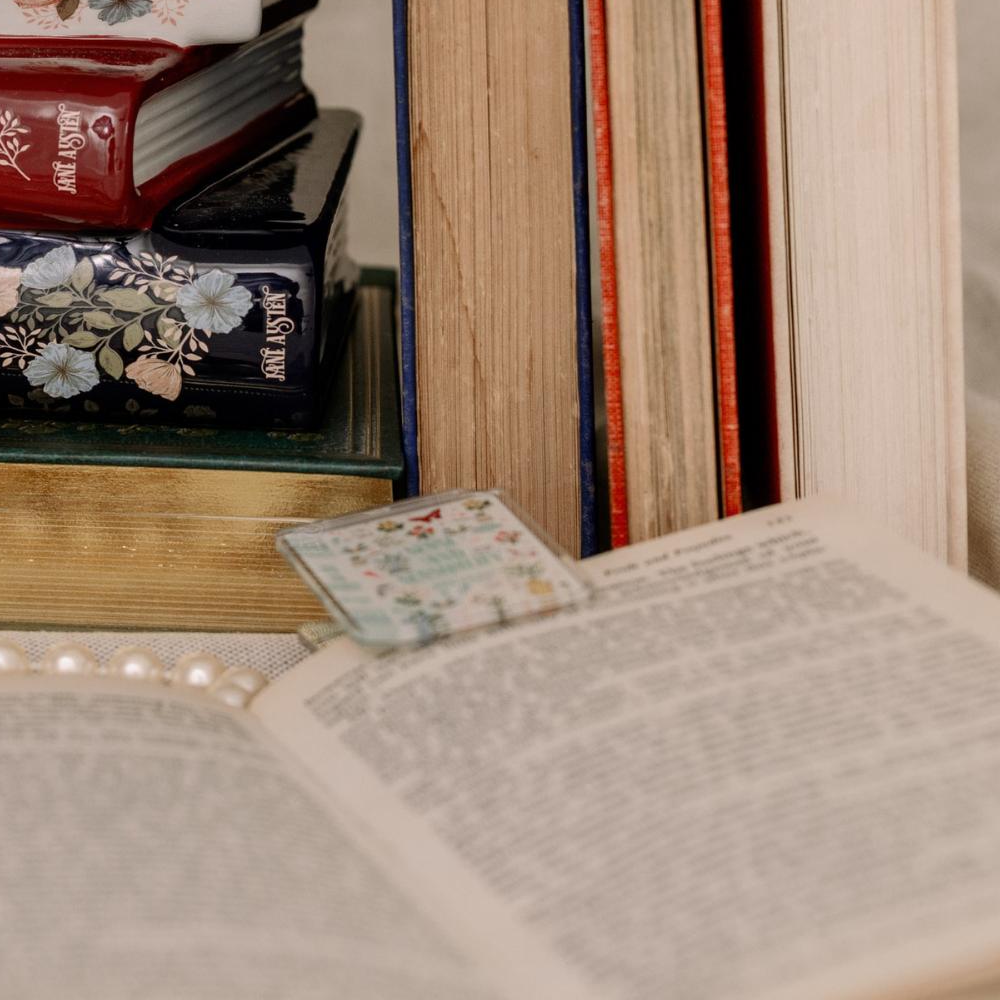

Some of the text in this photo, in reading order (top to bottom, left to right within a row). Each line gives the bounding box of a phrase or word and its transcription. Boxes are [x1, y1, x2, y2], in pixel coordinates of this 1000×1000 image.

[52, 103, 86, 195] JANE AUSTEN
[260, 285, 295, 382] JANE AUSTEN
